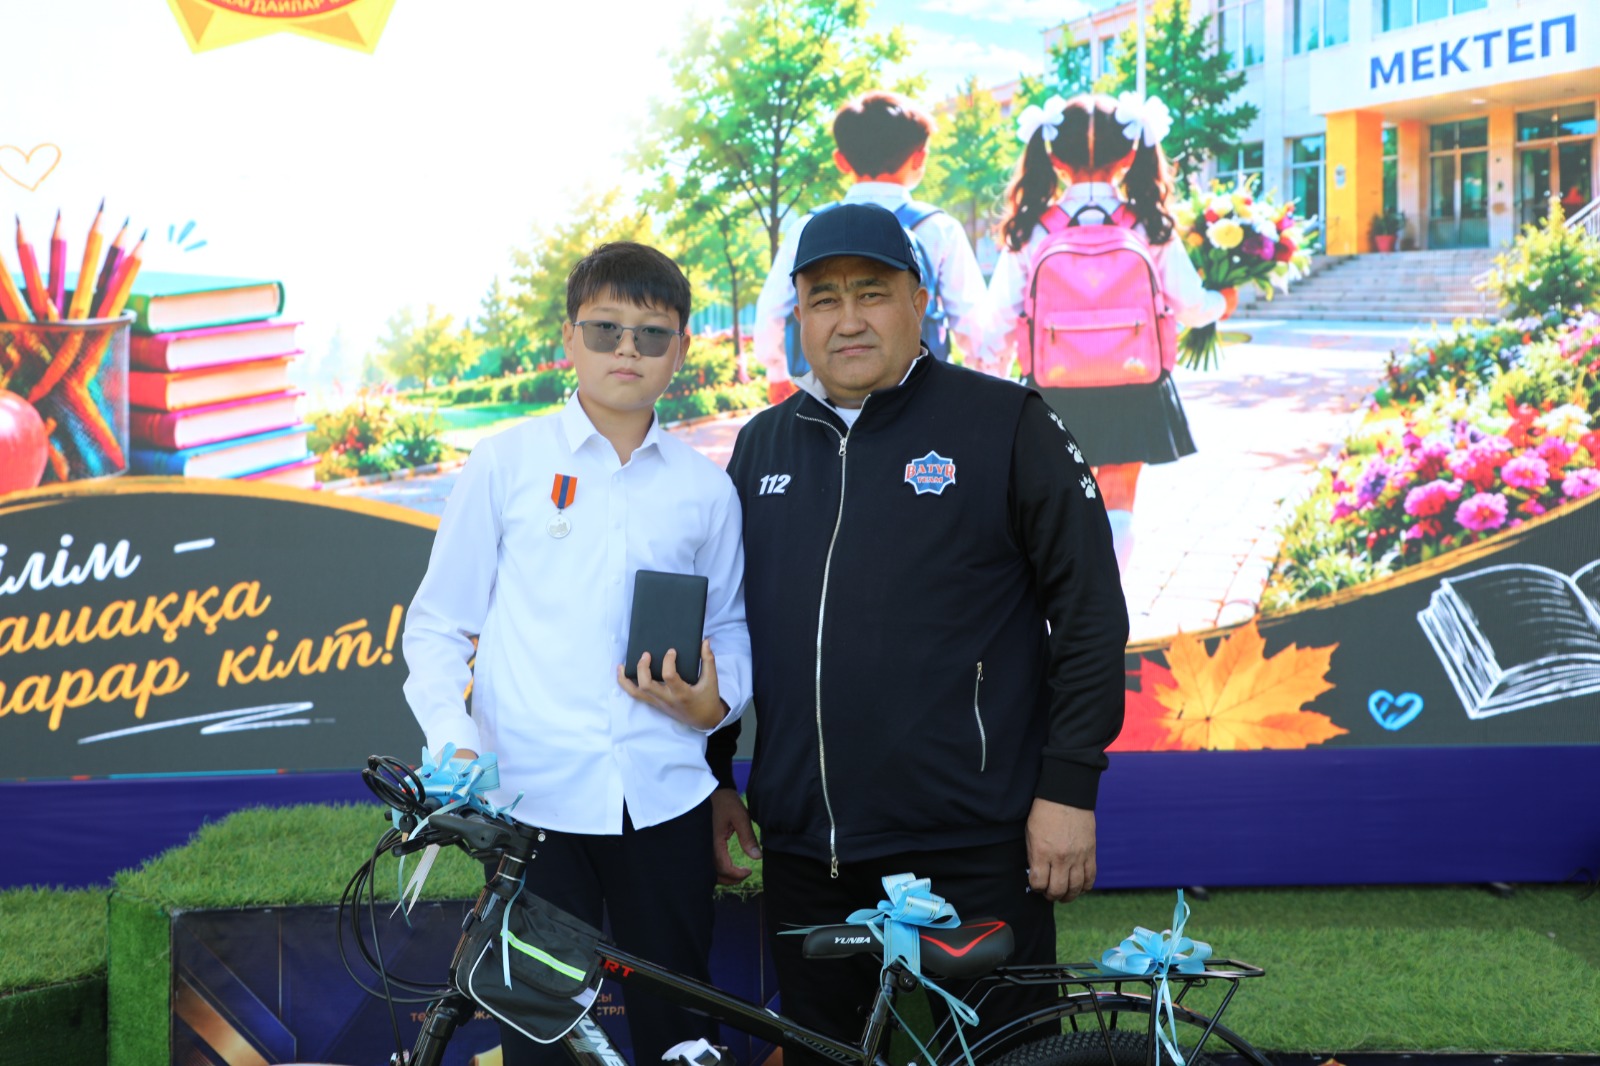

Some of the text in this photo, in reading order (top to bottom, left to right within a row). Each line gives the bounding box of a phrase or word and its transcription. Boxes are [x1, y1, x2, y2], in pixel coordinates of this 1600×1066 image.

[1369, 13, 1577, 90] МЕКТЕП
[758, 473, 792, 496] 112
[905, 463, 956, 482] BATYR
[917, 476, 944, 484] TEAM
[0, 533, 141, 595] ілім
[0, 580, 271, 657] ашаққа
[0, 655, 190, 731] арар
[834, 936, 871, 945] YUNBA
